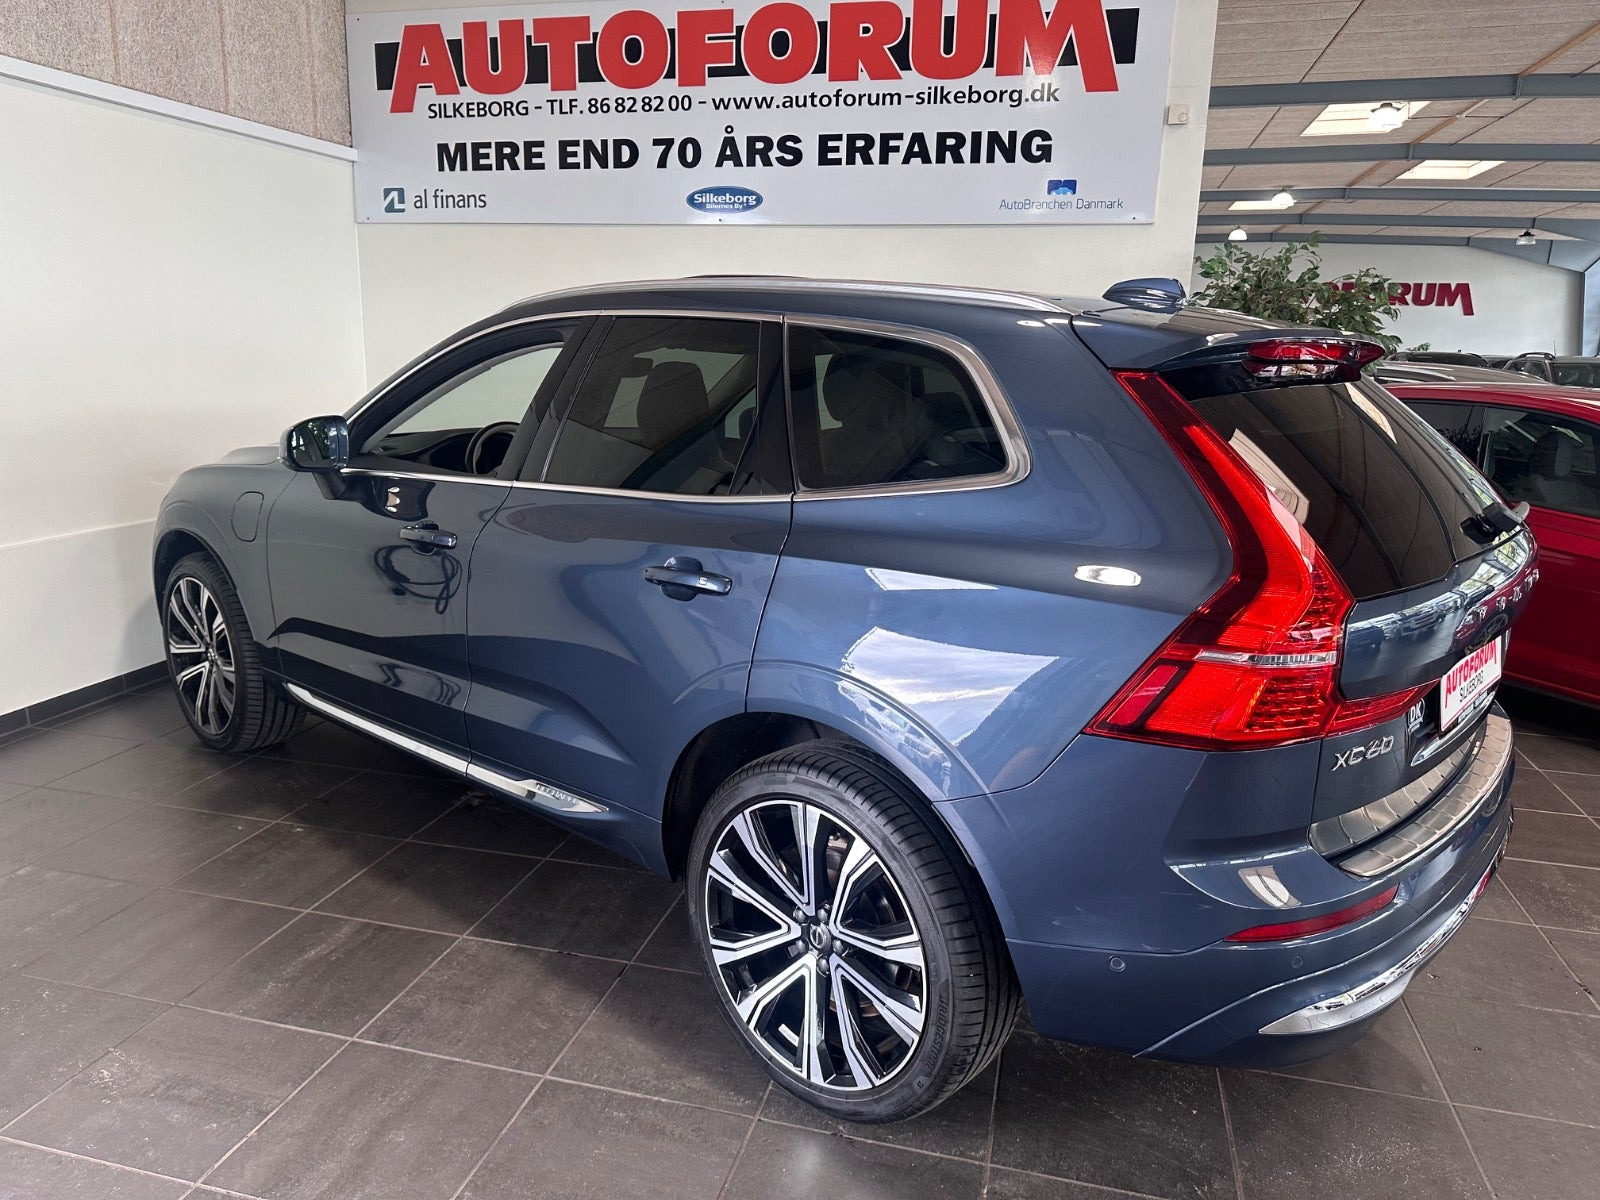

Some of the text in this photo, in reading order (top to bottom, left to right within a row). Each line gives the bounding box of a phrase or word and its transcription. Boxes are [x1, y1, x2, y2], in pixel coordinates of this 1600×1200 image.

[389, 0, 1120, 113] AUTOFORUM
[427, 100, 529, 120] SILKEBORG
[545, 98, 584, 116] TLF.
[711, 84, 1061, 111] www.autoforum-silkeborg.dk
[436, 124, 1053, 172] MERE END 70 ÅRS ERFARING
[413, 188, 487, 209] al finans
[693, 193, 757, 206] Silkeborg
[998, 198, 1124, 210] AutoBranchen Danmark
[1444, 639, 1497, 709] AUTOFORUM
[1409, 700, 1424, 723] DK
[1330, 735, 1395, 772] XC60
